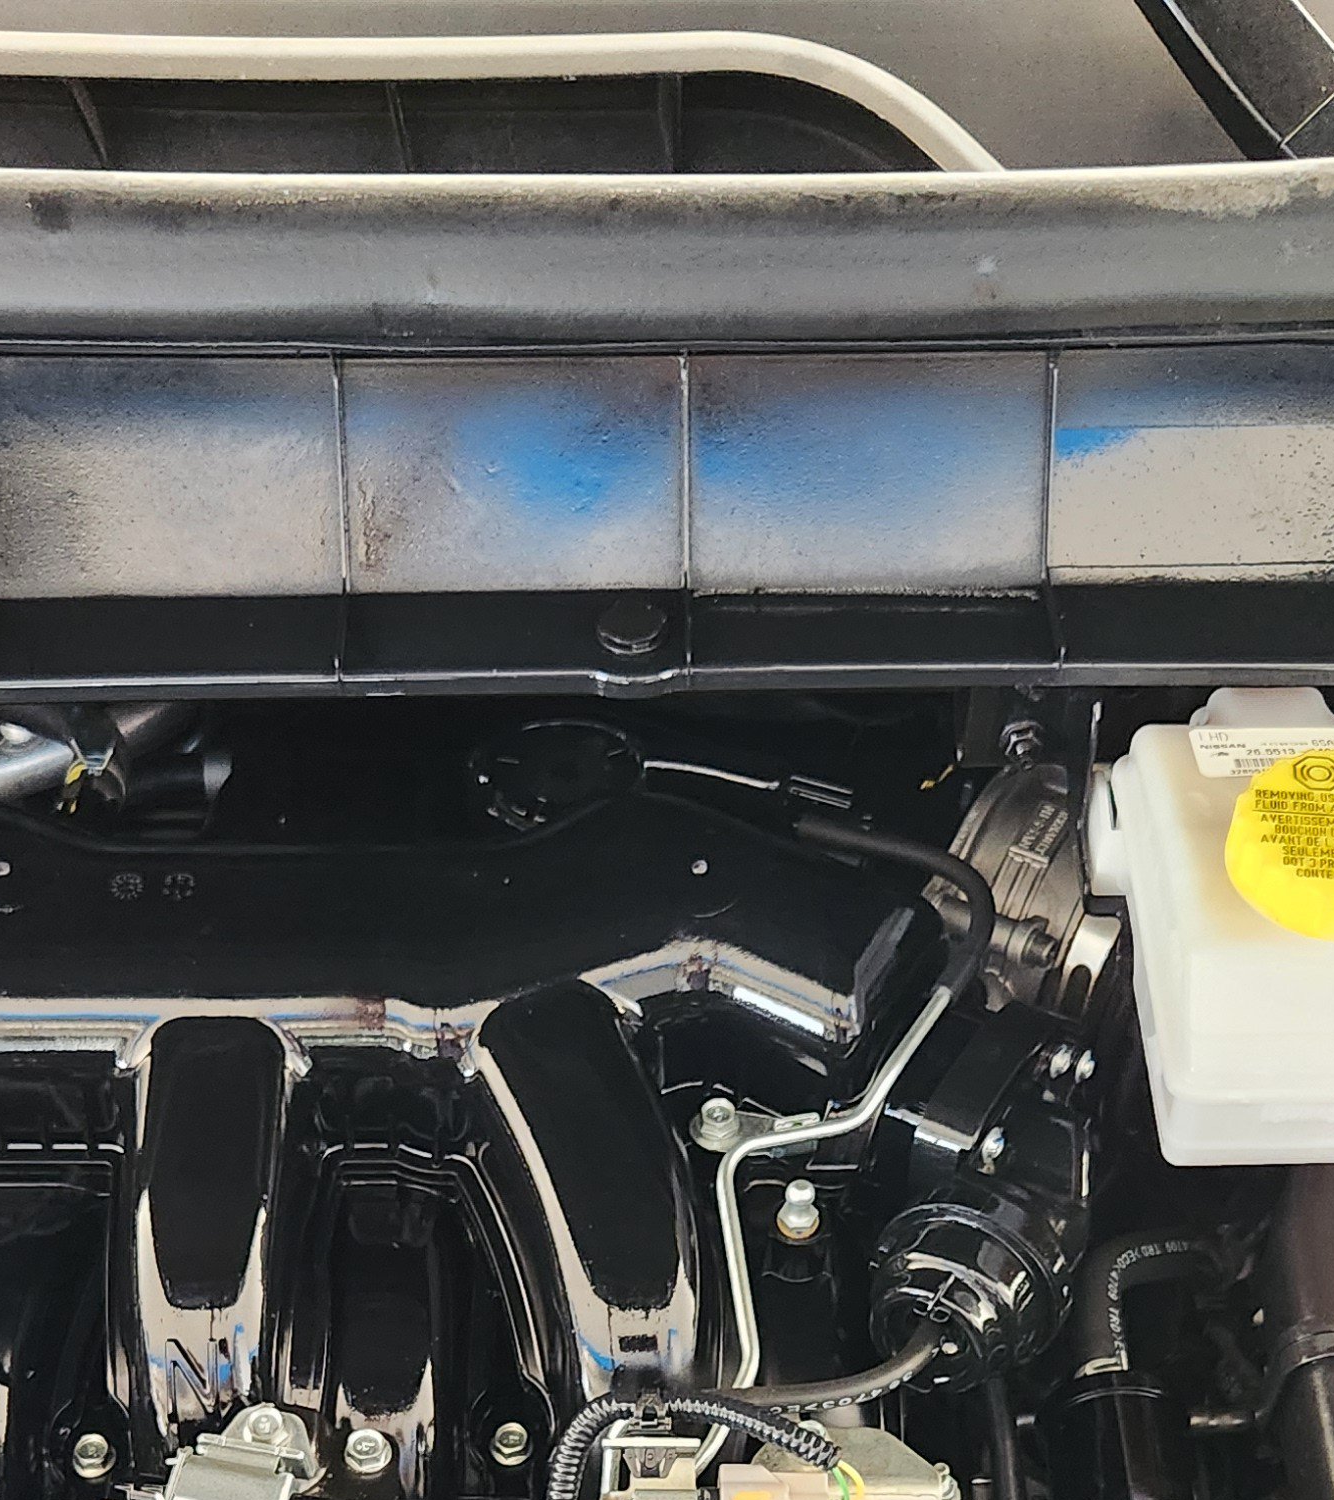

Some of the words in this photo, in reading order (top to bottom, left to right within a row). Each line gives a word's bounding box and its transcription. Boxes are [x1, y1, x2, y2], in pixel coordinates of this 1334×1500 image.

[1255, 799, 1287, 810] FLUID
[1293, 801, 1326, 812] FROM
[1274, 825, 1327, 838] BOUCHON
[1261, 835, 1302, 846] AVANT
[1307, 837, 1320, 847] DE
[1283, 857, 1304, 867] DOT
[1309, 858, 1317, 868] 3
